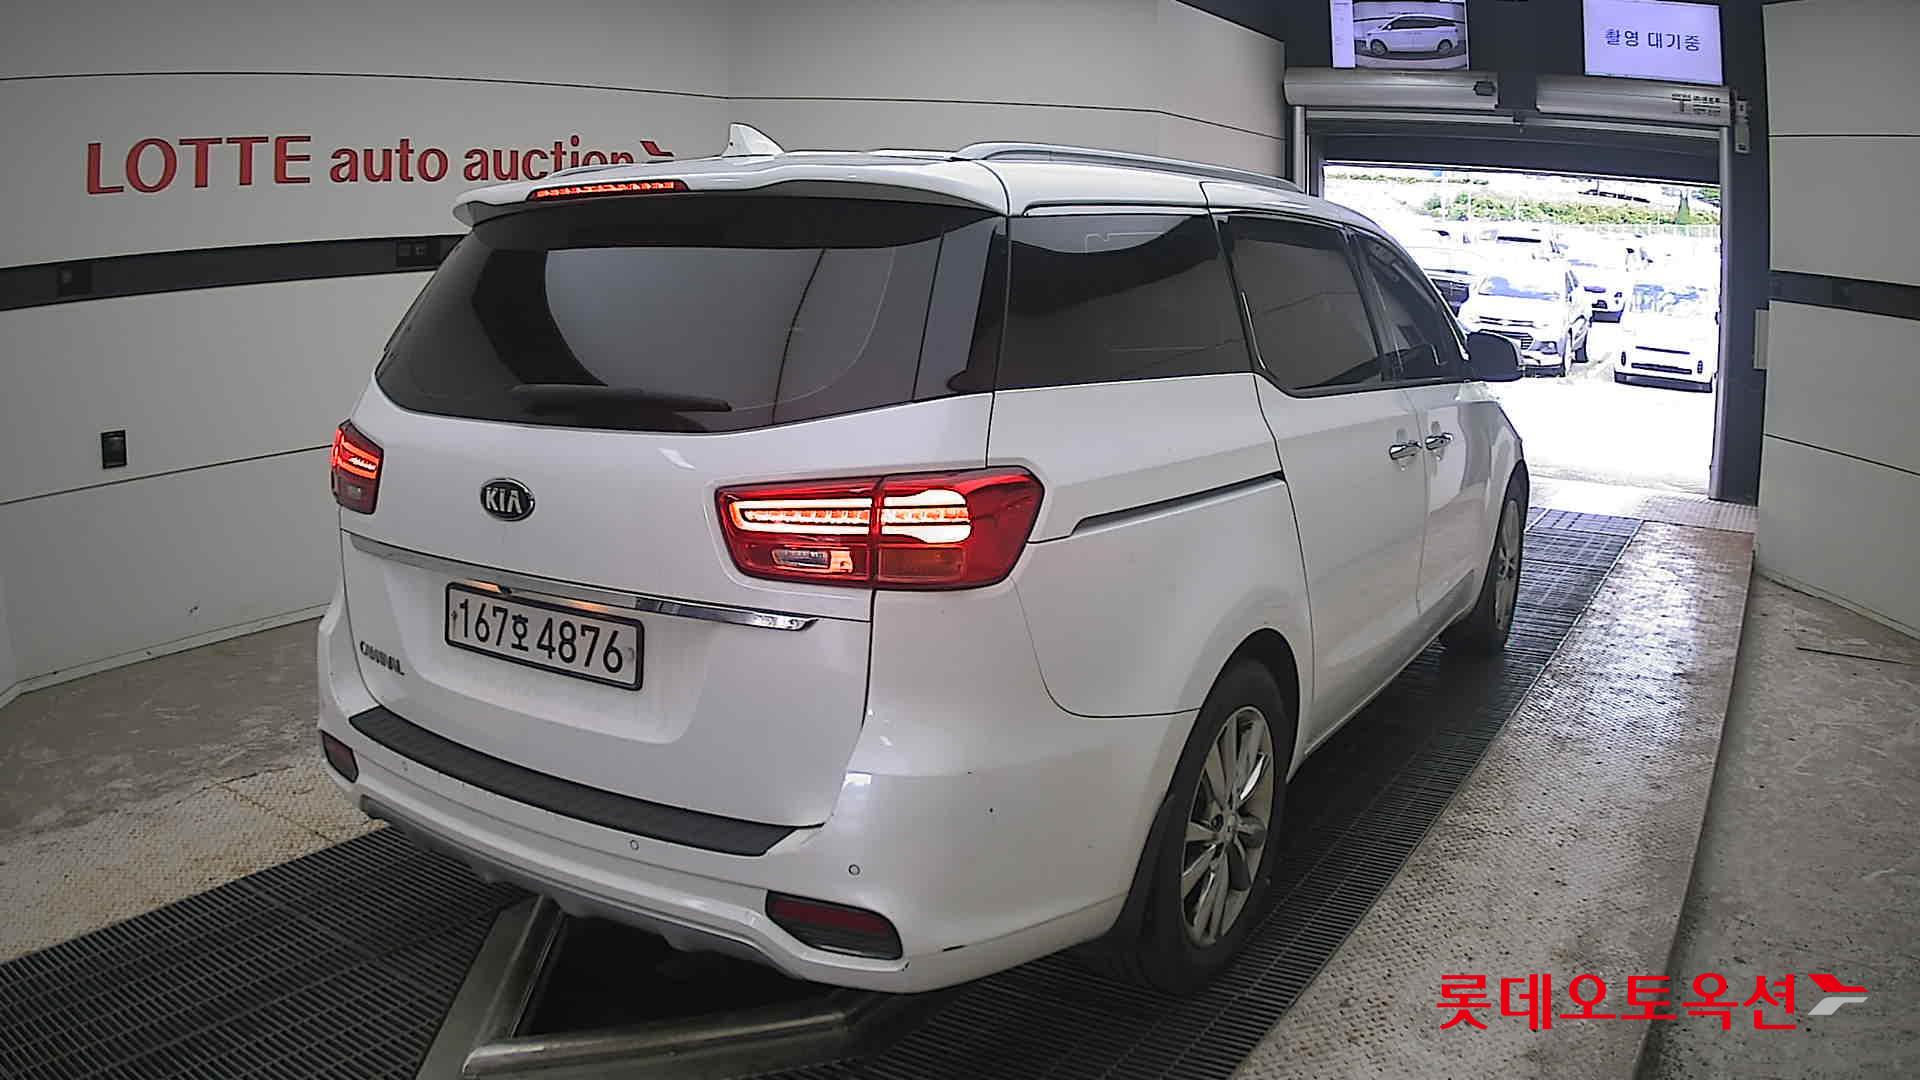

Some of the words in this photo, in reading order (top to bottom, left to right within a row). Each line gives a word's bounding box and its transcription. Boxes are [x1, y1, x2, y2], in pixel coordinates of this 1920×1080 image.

[1647, 32, 1701, 52] 대기중
[87, 135, 312, 195] LOTTE
[329, 137, 449, 183] auto
[485, 487, 523, 514] KIA
[459, 598, 624, 674] 167호4876
